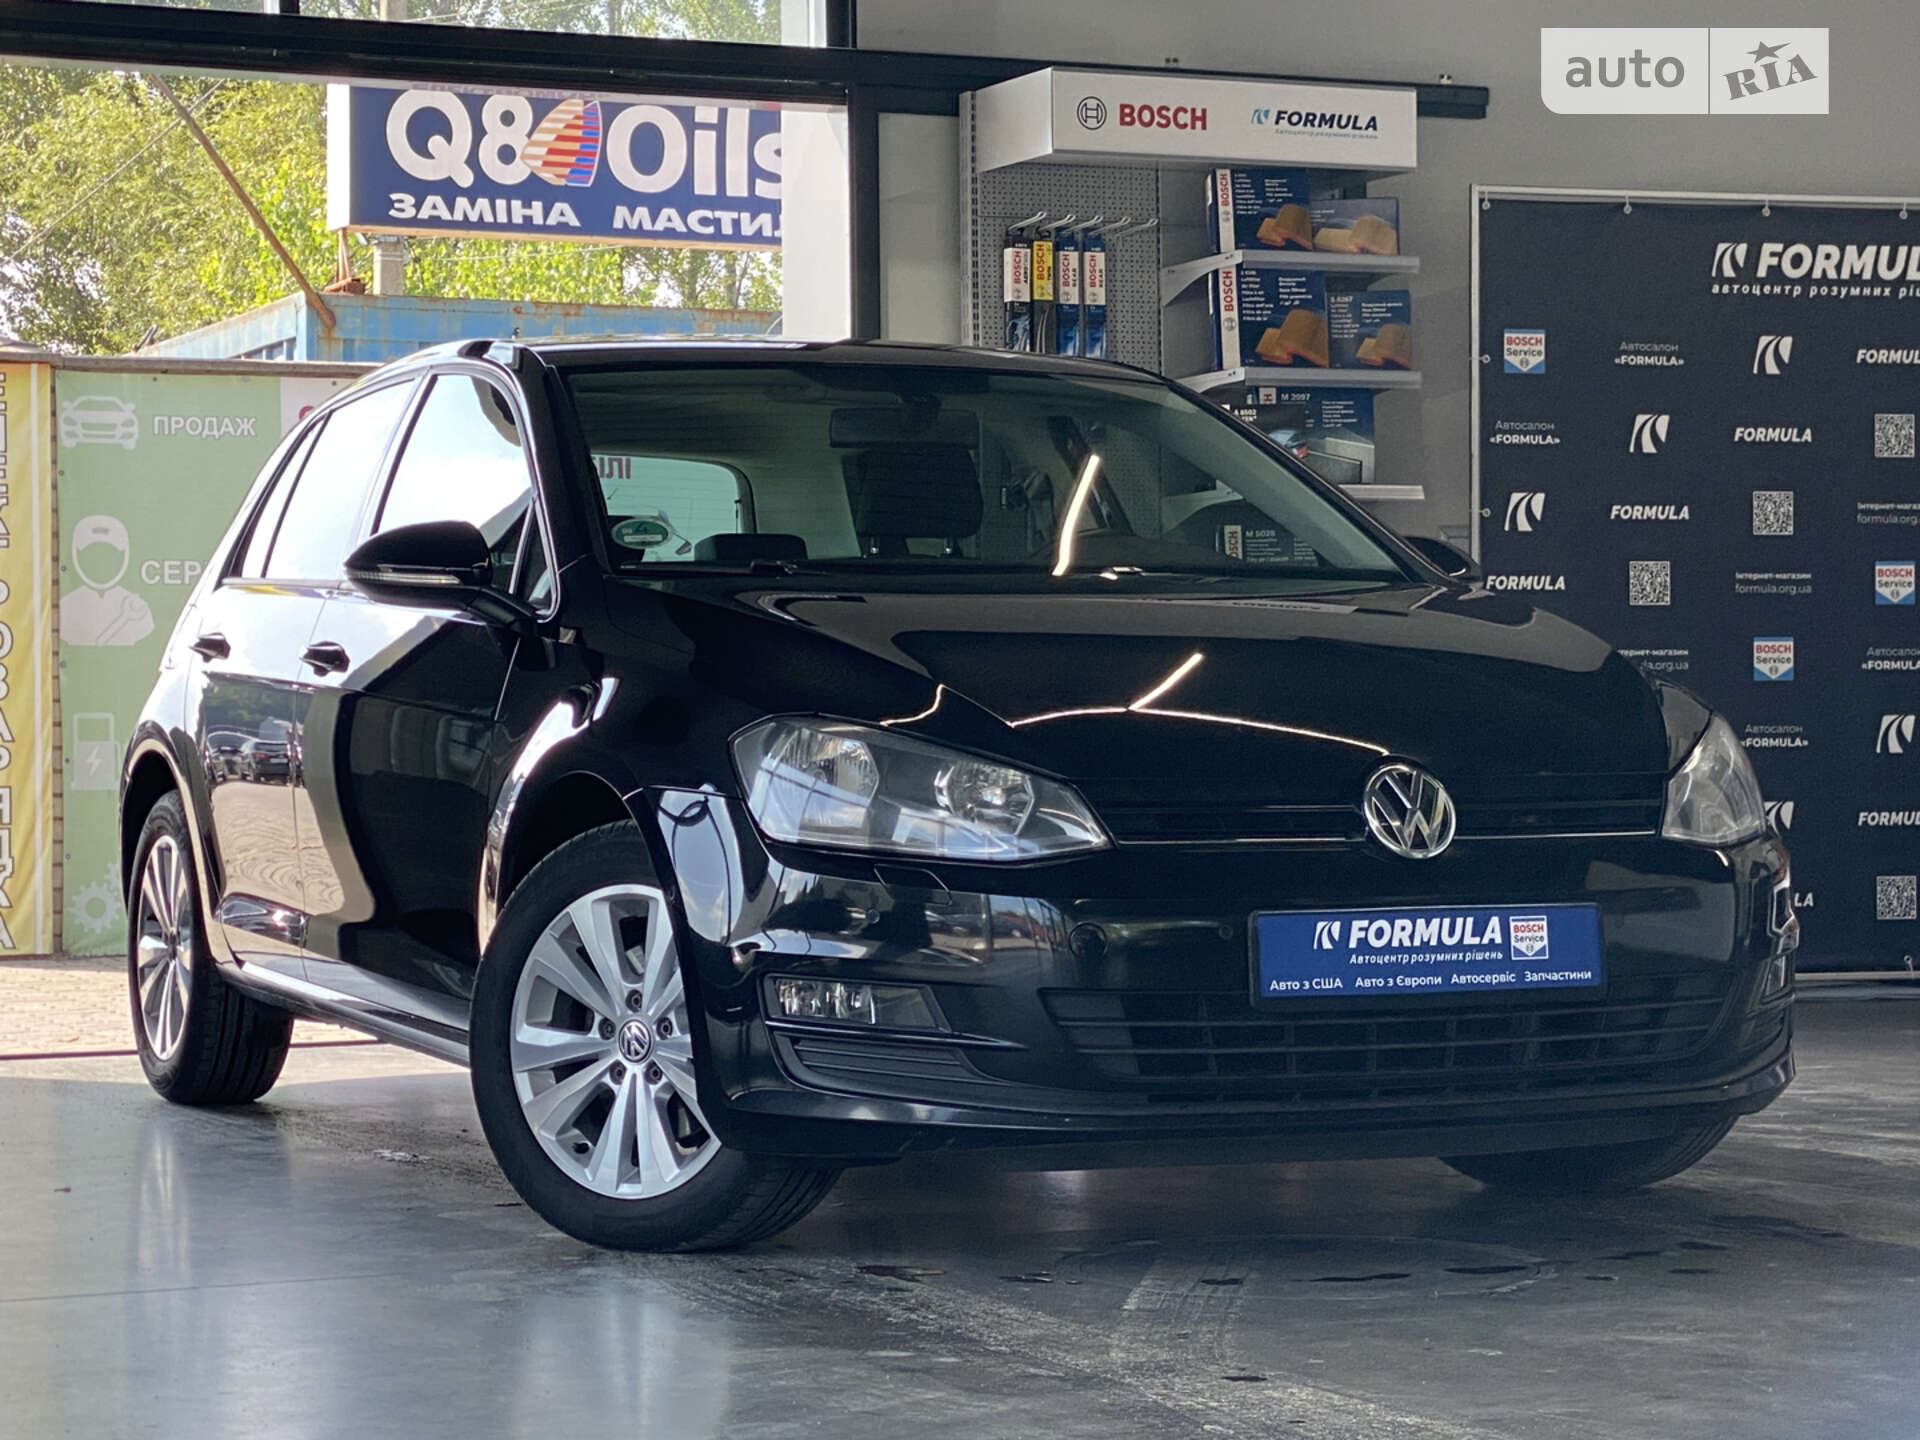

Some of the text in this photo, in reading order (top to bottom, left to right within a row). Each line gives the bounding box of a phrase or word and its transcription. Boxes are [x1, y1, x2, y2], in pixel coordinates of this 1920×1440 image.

[1119, 103, 1208, 131] BOSCH
[1275, 110, 1378, 131] FORMULA
[385, 88, 533, 188] Q8
[1220, 173, 1230, 207] BOSCH
[388, 193, 581, 228] ЗАМІНА
[1014, 250, 1022, 285] BOSCH
[1036, 244, 1045, 280] BOSCH
[1089, 254, 1097, 288] BOSCH
[1223, 271, 1234, 312] BOSCH
[1712, 284, 1801, 297] автоцентр
[1809, 284, 1891, 299] розумних
[1506, 336, 1543, 347] BOSCH
[1619, 341, 1679, 352] Автосалон
[1506, 348, 1543, 357] Service
[1614, 355, 1685, 366] «FORMULA»
[152, 415, 257, 439] ПРОДАЖ
[1495, 420, 1554, 431] Автосалон
[1489, 434, 1560, 445] «FORMULA»
[1734, 428, 1812, 443] FORMULA
[1610, 505, 1689, 520] FORMULA
[1228, 531, 1238, 557] OSCH
[140, 560, 205, 585] СЕР
[1877, 568, 1913, 577] BOSCH
[1486, 575, 1565, 591] FORMULA
[1735, 584, 1812, 596] formula.org.ua
[1877, 579, 1913, 588] Service
[1755, 644, 1792, 654] BOSCH
[1755, 656, 1792, 664] Service
[1745, 724, 1803, 734] Автосалон
[1348, 916, 1502, 949] FORMULA
[1513, 924, 1544, 933] BOSCH
[1514, 934, 1544, 944] Service
[1350, 949, 1503, 965] Автоцентр розумних рішень
[1270, 977, 1343, 991] Авто з США
[1355, 975, 1443, 988] Авто з Європи
[1451, 970, 1517, 986] Автосервіс
[1524, 970, 1592, 983] Запчастини
